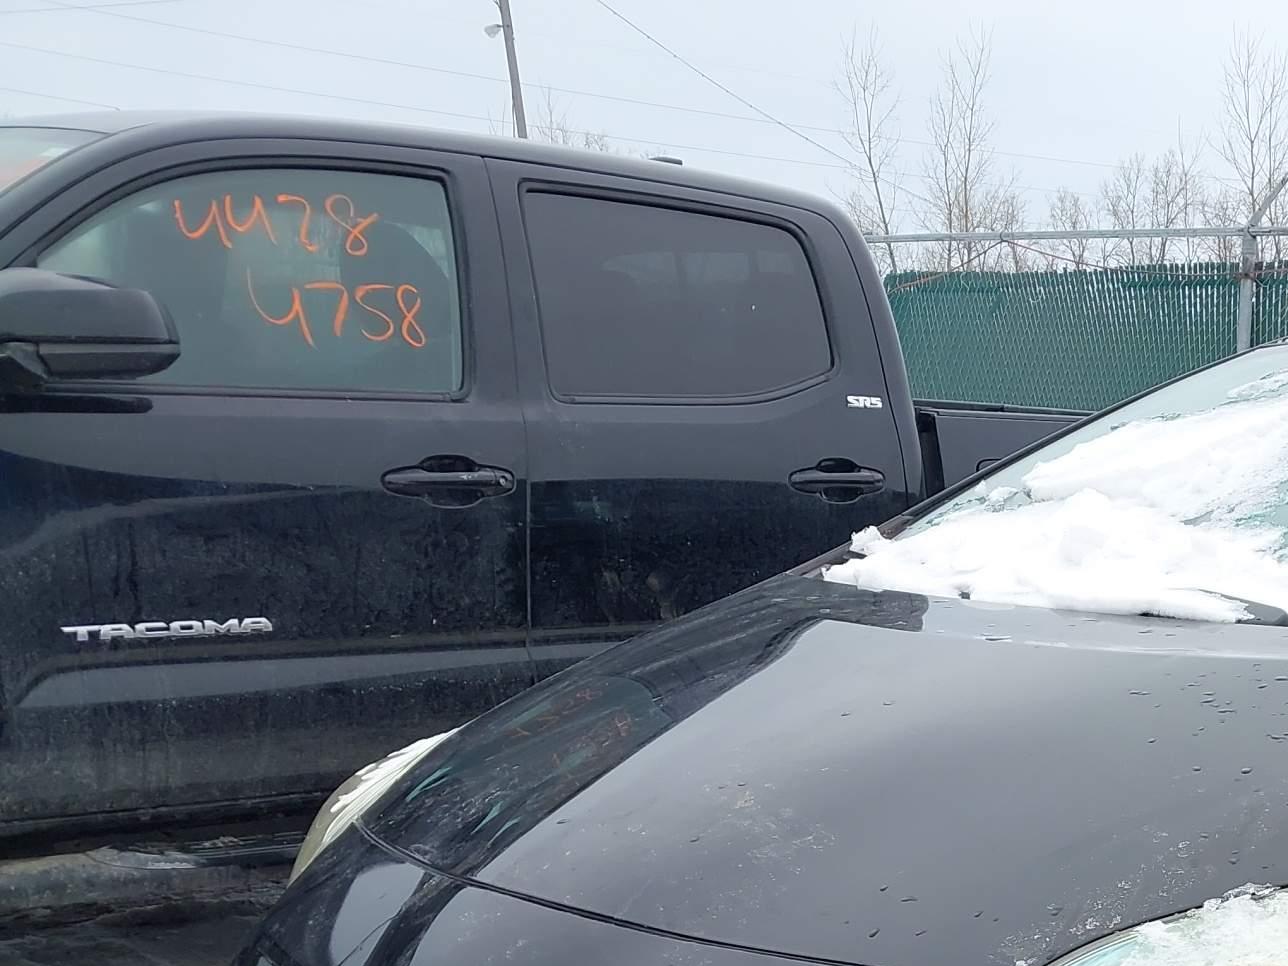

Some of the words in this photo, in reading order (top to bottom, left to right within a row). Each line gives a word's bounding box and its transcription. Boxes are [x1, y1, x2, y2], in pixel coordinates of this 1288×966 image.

[245, 264, 428, 351] 4758
[846, 395, 884, 410] SR5
[59, 616, 274, 642] TACOMA
